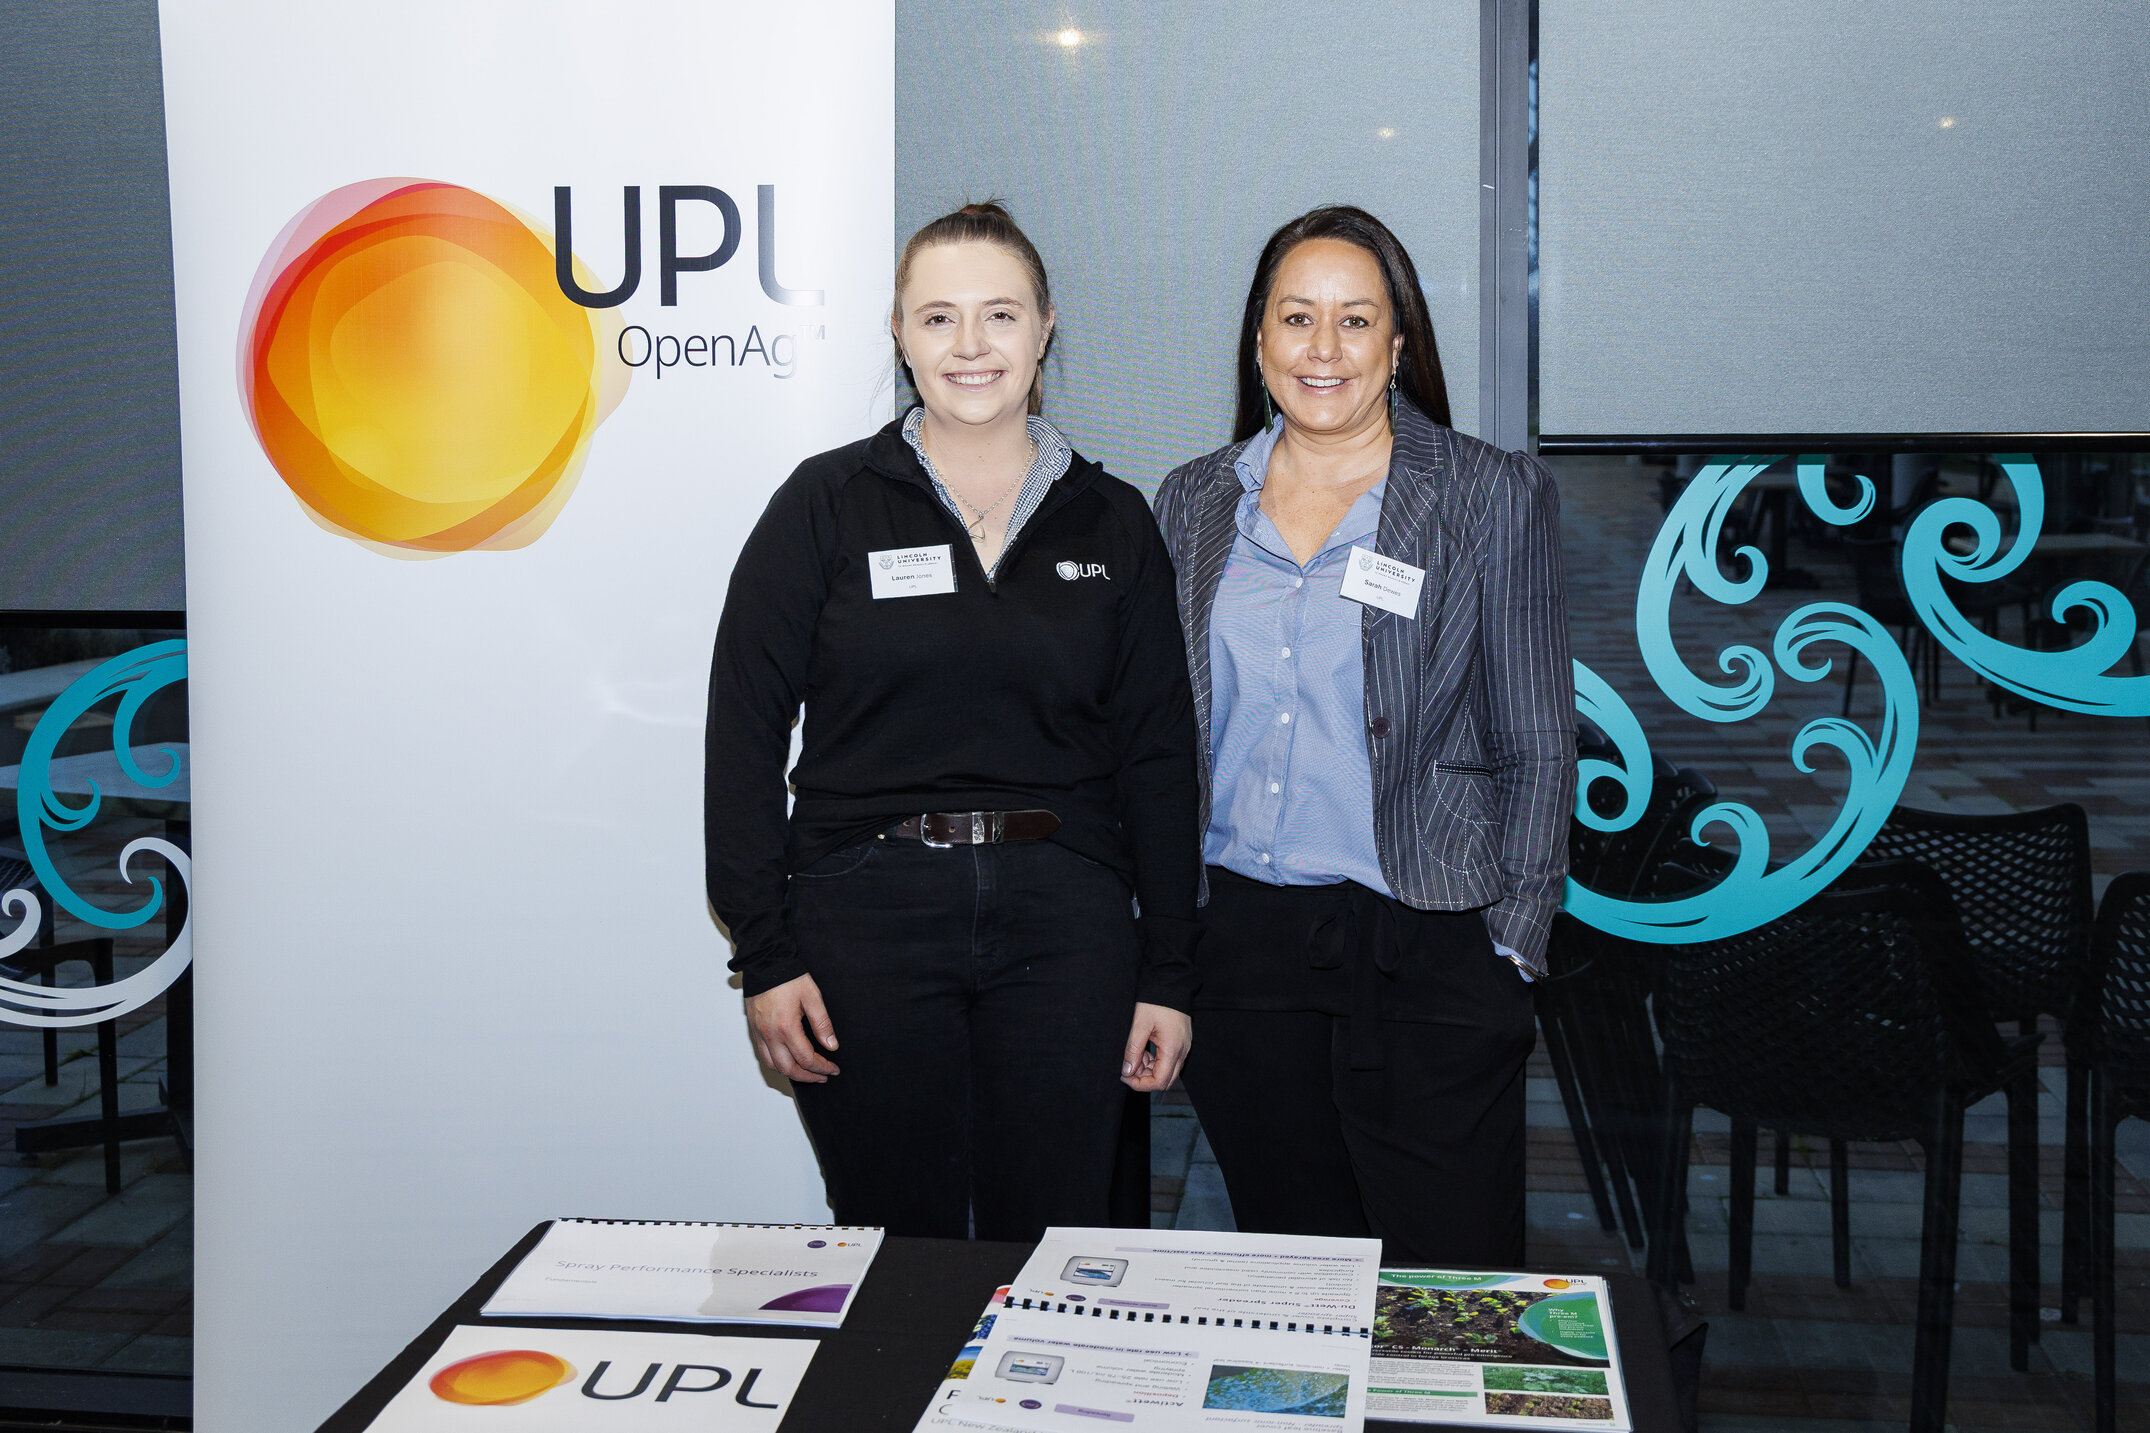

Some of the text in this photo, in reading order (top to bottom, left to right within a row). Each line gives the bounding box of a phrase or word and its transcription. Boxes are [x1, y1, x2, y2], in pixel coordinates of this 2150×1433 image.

[554, 184, 825, 309] UPL
[896, 552, 928, 560] LINCOLN
[897, 555, 942, 564] UNIVERSITY
[1079, 563, 1111, 581] UPL
[1376, 560, 1405, 573] LINCOLN
[1375, 566, 1416, 583] UNIVERSITY
[1364, 579, 1382, 591] Sarah
[555, 1260, 819, 1278] Spray Performance Specialists
[1013, 1336, 1045, 1344] volume
[581, 1360, 780, 1410] UPL
[1132, 1390, 1179, 1398] Deposition
[930, 1417, 953, 1425] UPL
[958, 1420, 987, 1430] New
